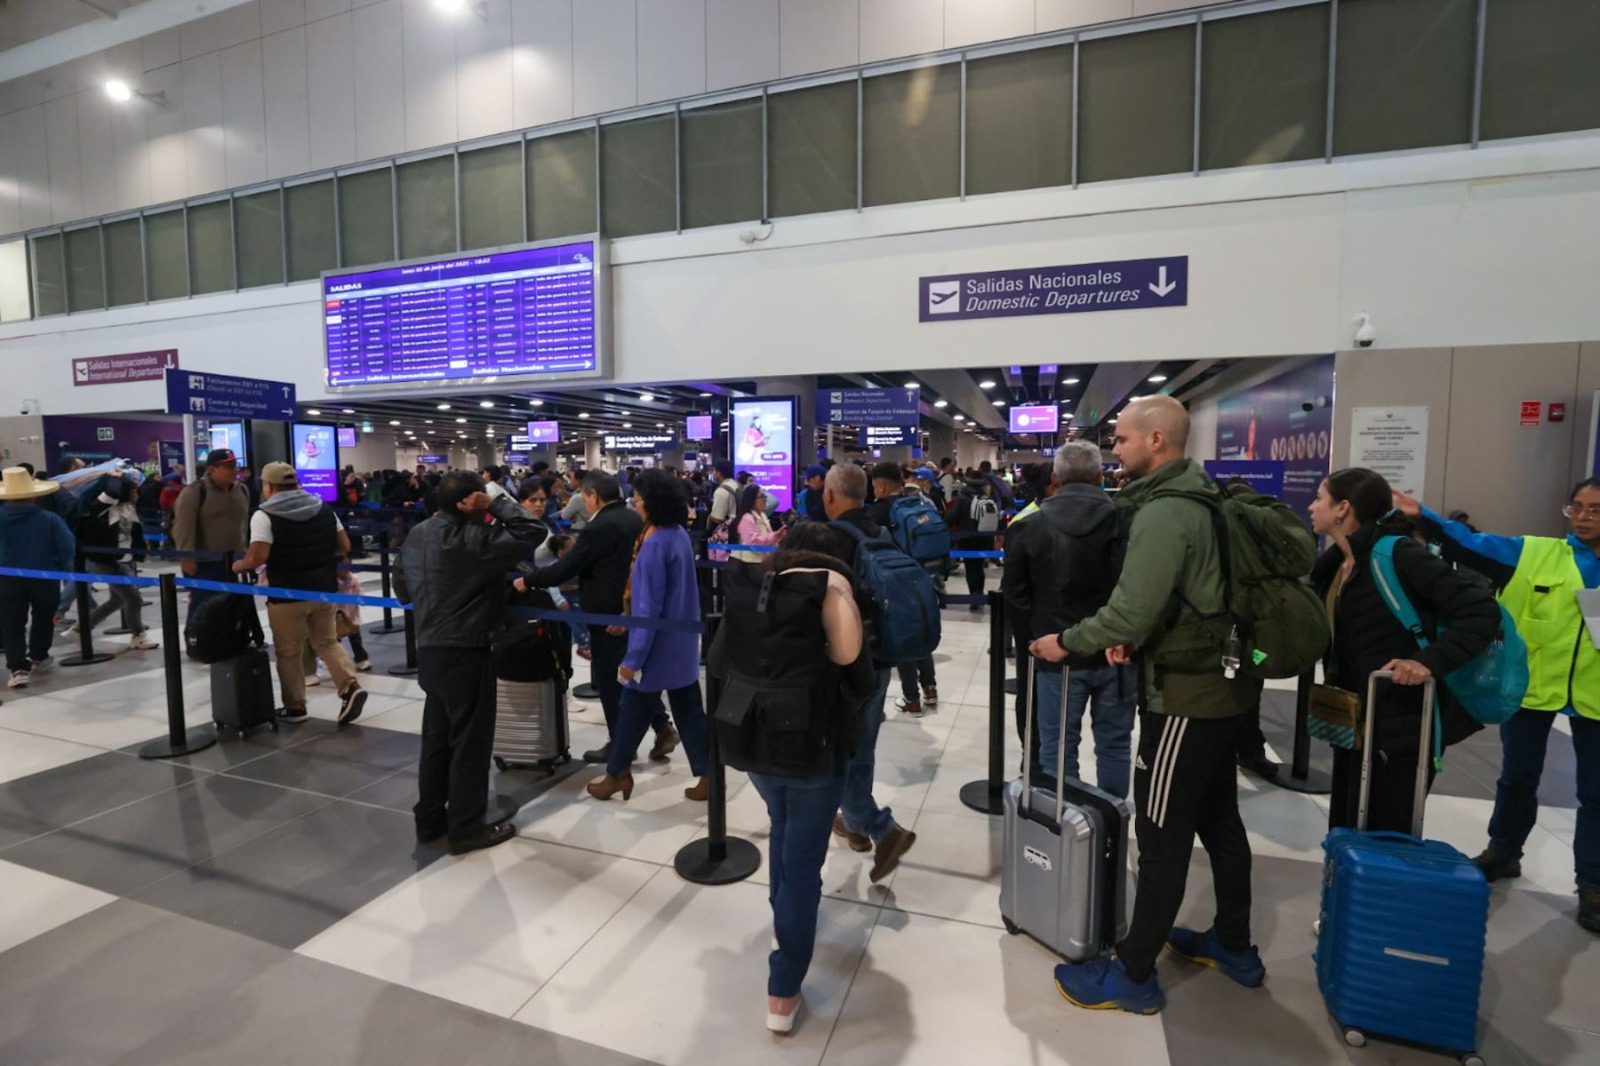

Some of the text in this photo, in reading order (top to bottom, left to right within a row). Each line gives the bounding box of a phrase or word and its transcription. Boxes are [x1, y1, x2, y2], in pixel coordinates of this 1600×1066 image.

[330, 282, 362, 293] SALIDAS
[966, 270, 1122, 294] Salidas Nacionales
[966, 287, 1140, 312] Domestic Departures
